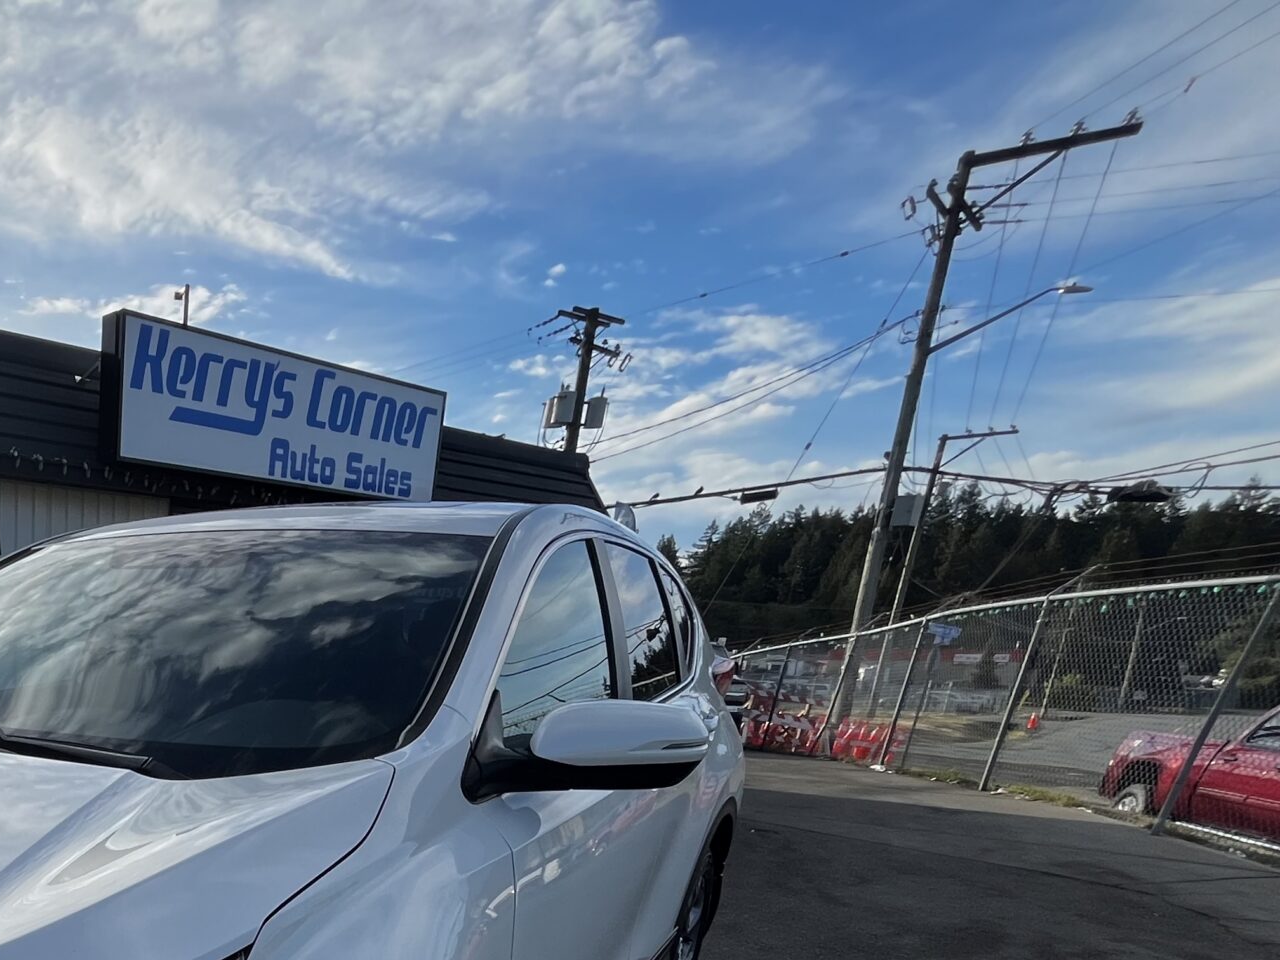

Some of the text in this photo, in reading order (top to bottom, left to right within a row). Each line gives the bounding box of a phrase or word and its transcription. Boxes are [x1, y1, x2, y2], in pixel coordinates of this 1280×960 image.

[306, 368, 438, 449] Corner
[268, 437, 412, 498] Auto Sales
